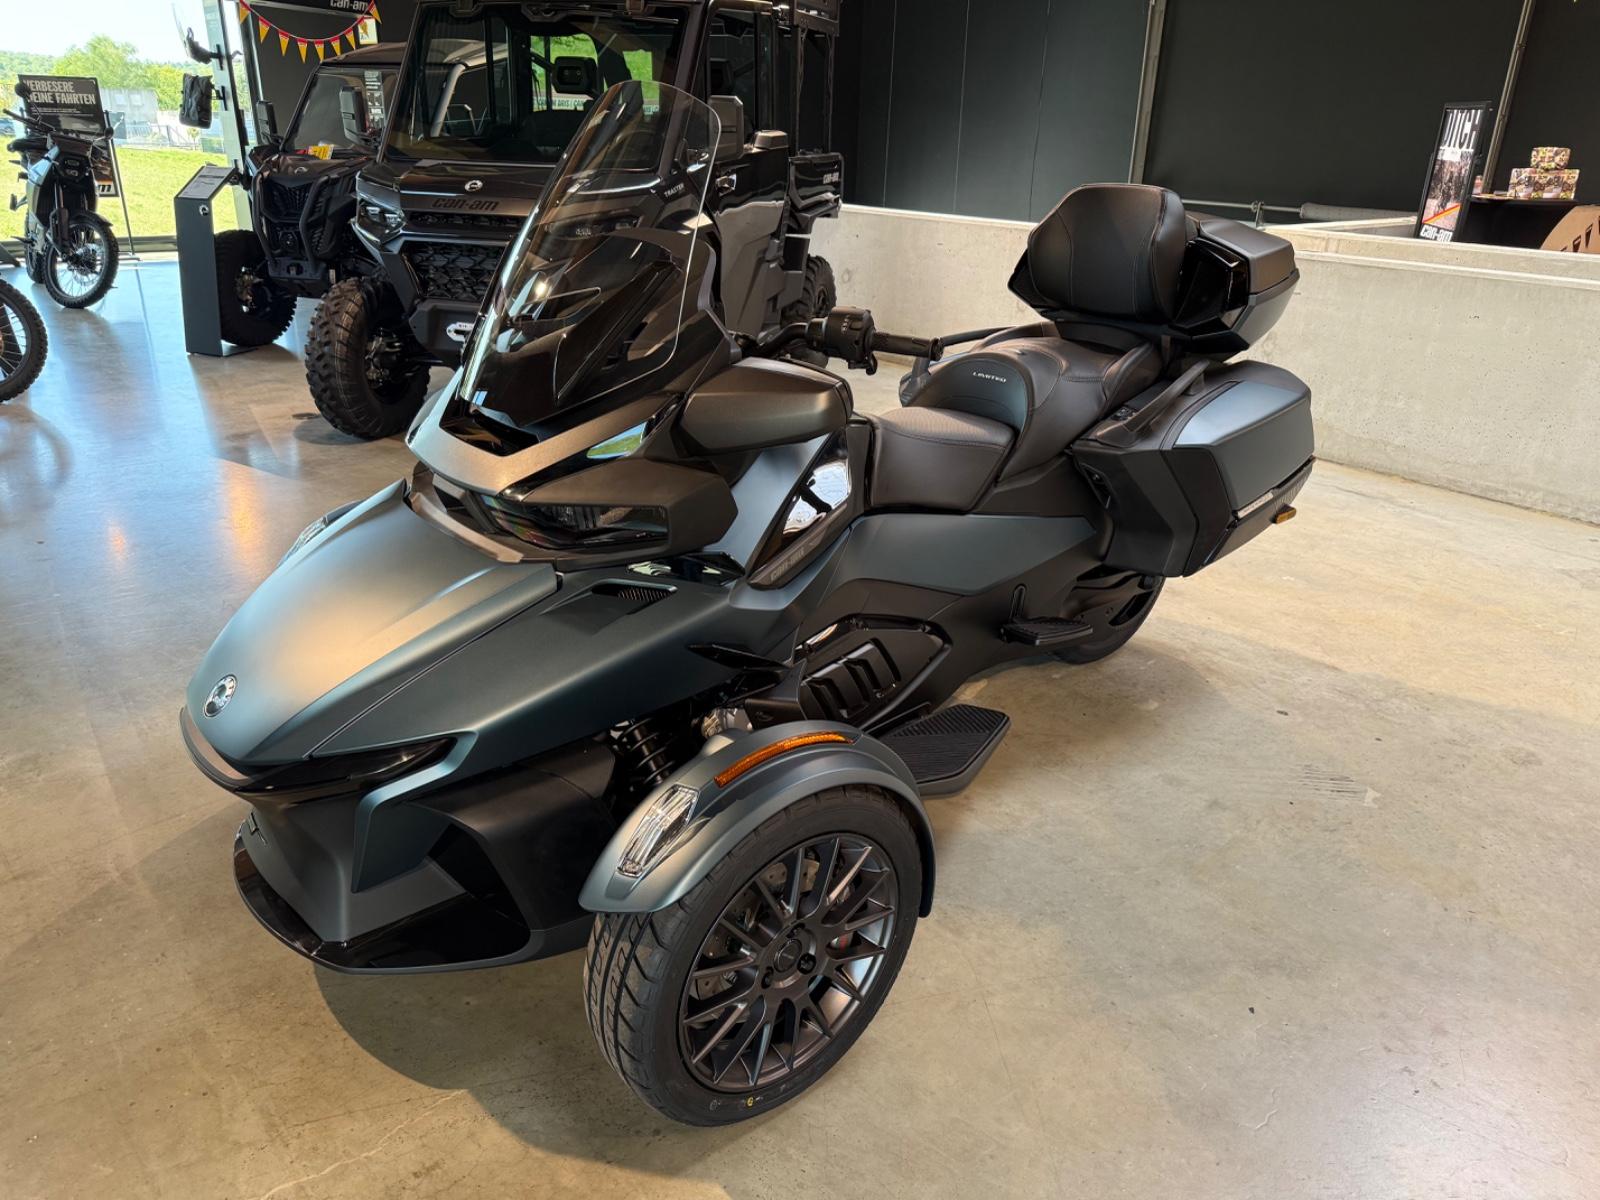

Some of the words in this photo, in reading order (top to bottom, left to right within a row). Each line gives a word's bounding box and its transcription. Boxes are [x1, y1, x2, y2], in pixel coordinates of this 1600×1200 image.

[330, 0, 368, 11] can-am
[55, 93, 96, 104] FAHRTEN
[432, 198, 499, 211] can-am
[1420, 224, 1453, 242] can-am
